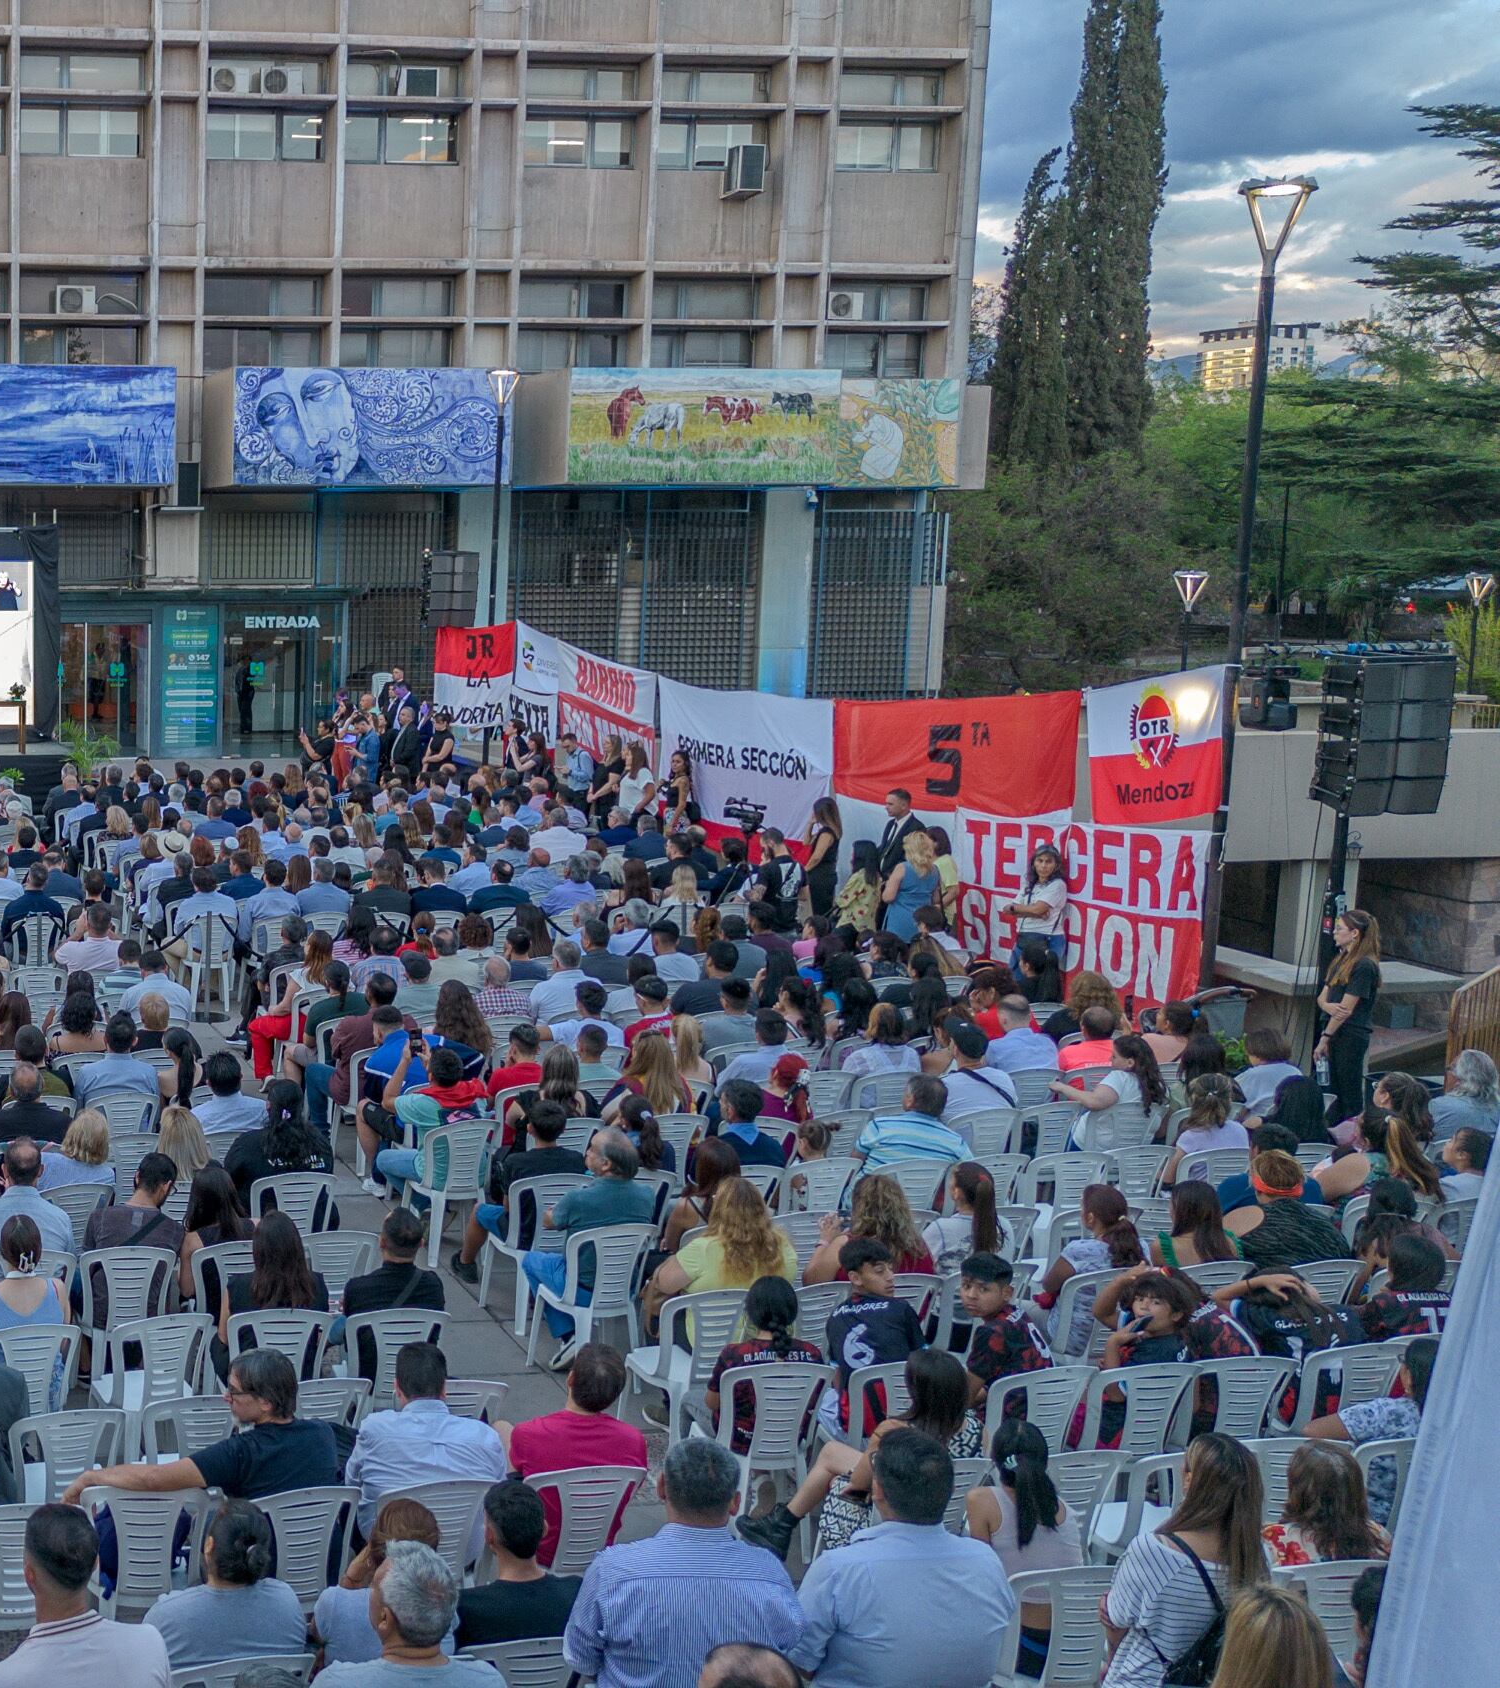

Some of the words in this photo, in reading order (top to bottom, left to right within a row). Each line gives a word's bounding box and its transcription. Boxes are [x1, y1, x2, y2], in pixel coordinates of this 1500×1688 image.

[244, 615, 321, 629] ENTRADA
[466, 633, 494, 660] JR
[466, 669, 491, 689] LA
[575, 655, 636, 715] BARRIO
[432, 702, 504, 724] AVORITA
[1139, 718, 1169, 737] OTR
[678, 734, 736, 769] PRIMERA
[741, 747, 807, 780] SECCIÓN
[962, 889, 1174, 1004] SECION
[843, 1323, 875, 1369] 6
